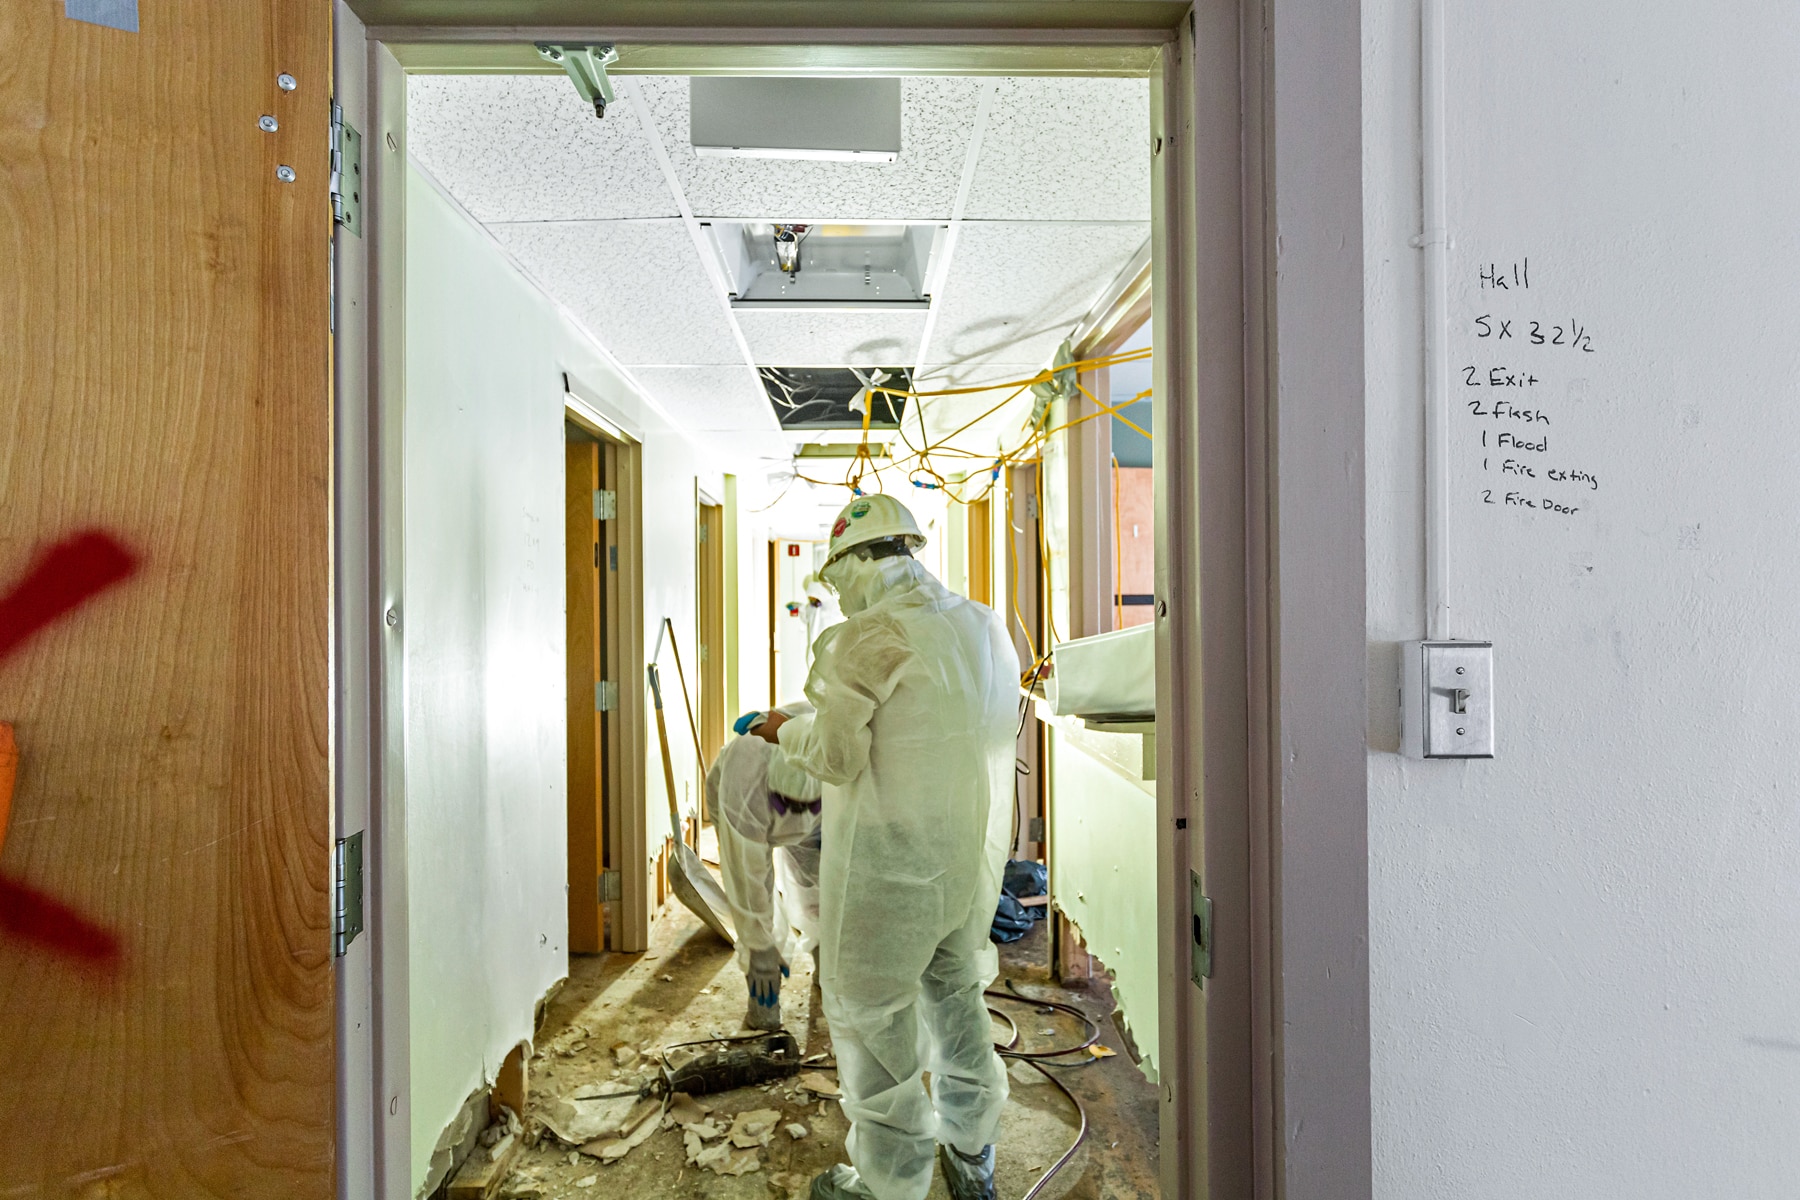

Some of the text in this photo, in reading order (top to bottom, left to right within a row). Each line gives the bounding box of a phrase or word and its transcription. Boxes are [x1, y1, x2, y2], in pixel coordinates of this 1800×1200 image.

[1479, 256, 1529, 290] Hall
[1461, 365, 1539, 388] 2 Exit
[1467, 399, 1488, 416] 2
[1497, 432, 1548, 453] Flood
[1502, 458, 1536, 479] Fire
[1547, 468, 1598, 491] exting
[1481, 488, 1579, 516] 2 Fire Door
